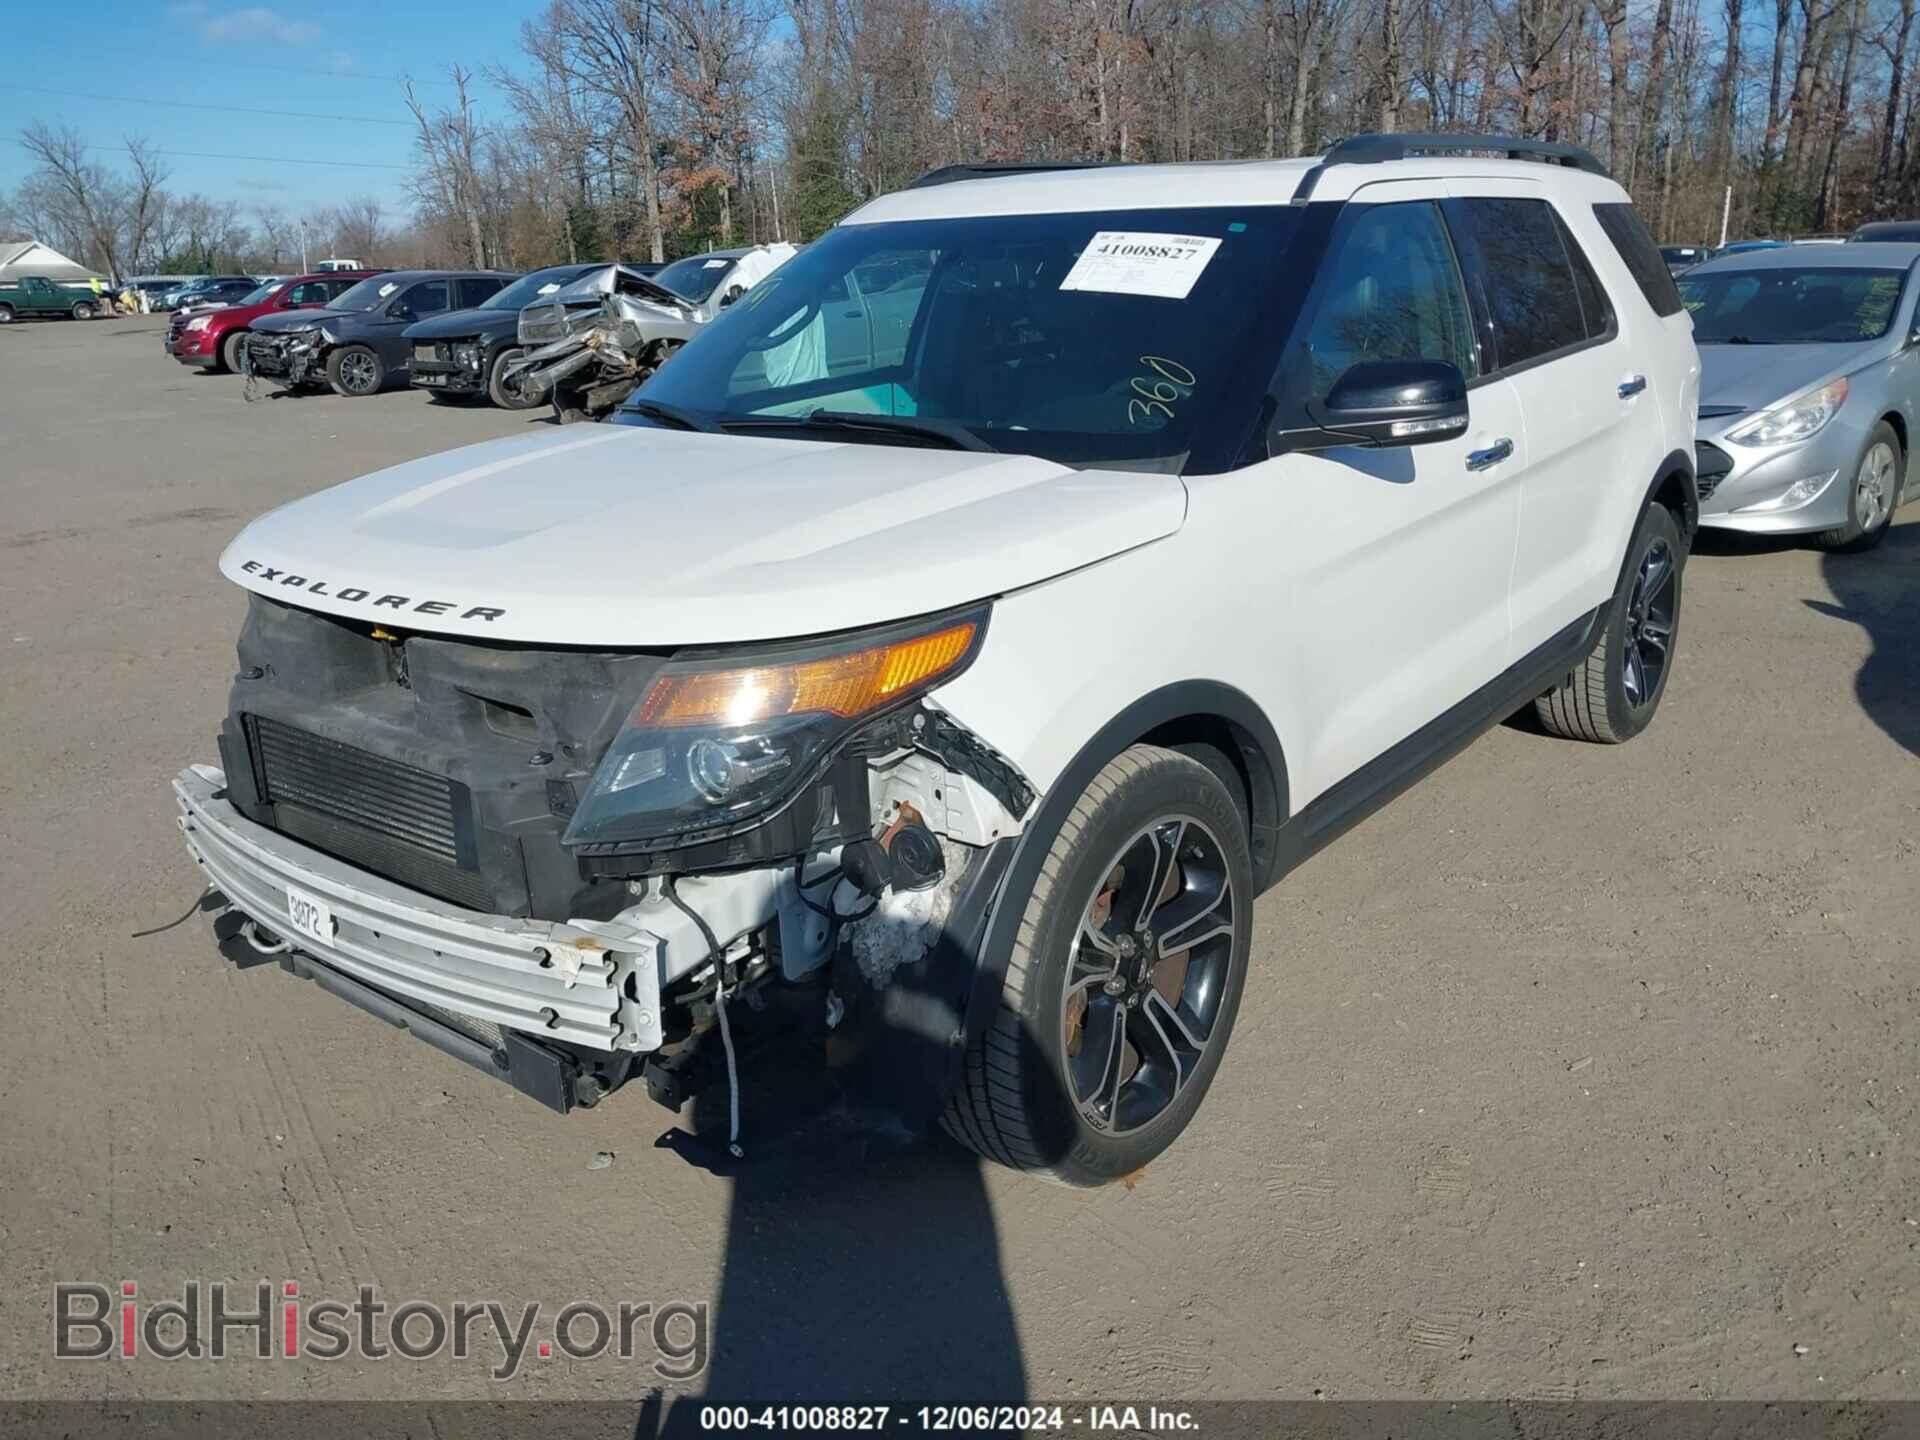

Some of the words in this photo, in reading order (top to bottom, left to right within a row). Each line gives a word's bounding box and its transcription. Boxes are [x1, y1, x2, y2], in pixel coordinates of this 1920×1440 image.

[1097, 243, 1199, 261] 41008827
[1128, 355, 1196, 424] 360
[241, 560, 506, 621] EXPLORER
